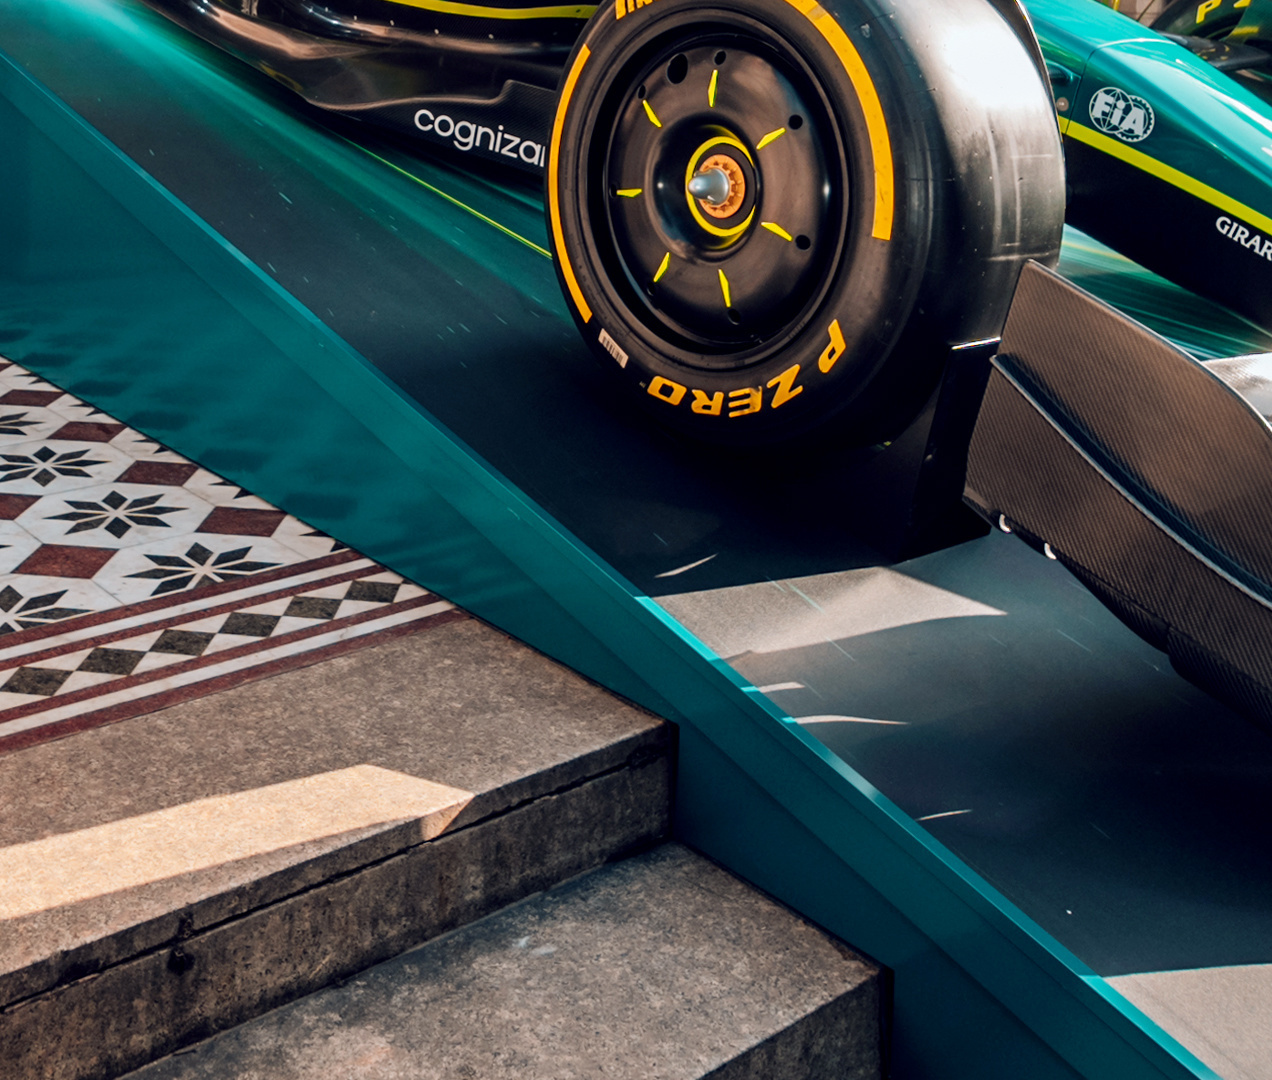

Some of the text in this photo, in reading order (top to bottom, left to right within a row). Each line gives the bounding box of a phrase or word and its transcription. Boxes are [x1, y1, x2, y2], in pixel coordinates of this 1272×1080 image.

[413, 108, 546, 168] cogniza
[646, 318, 847, 418] P ZERO
